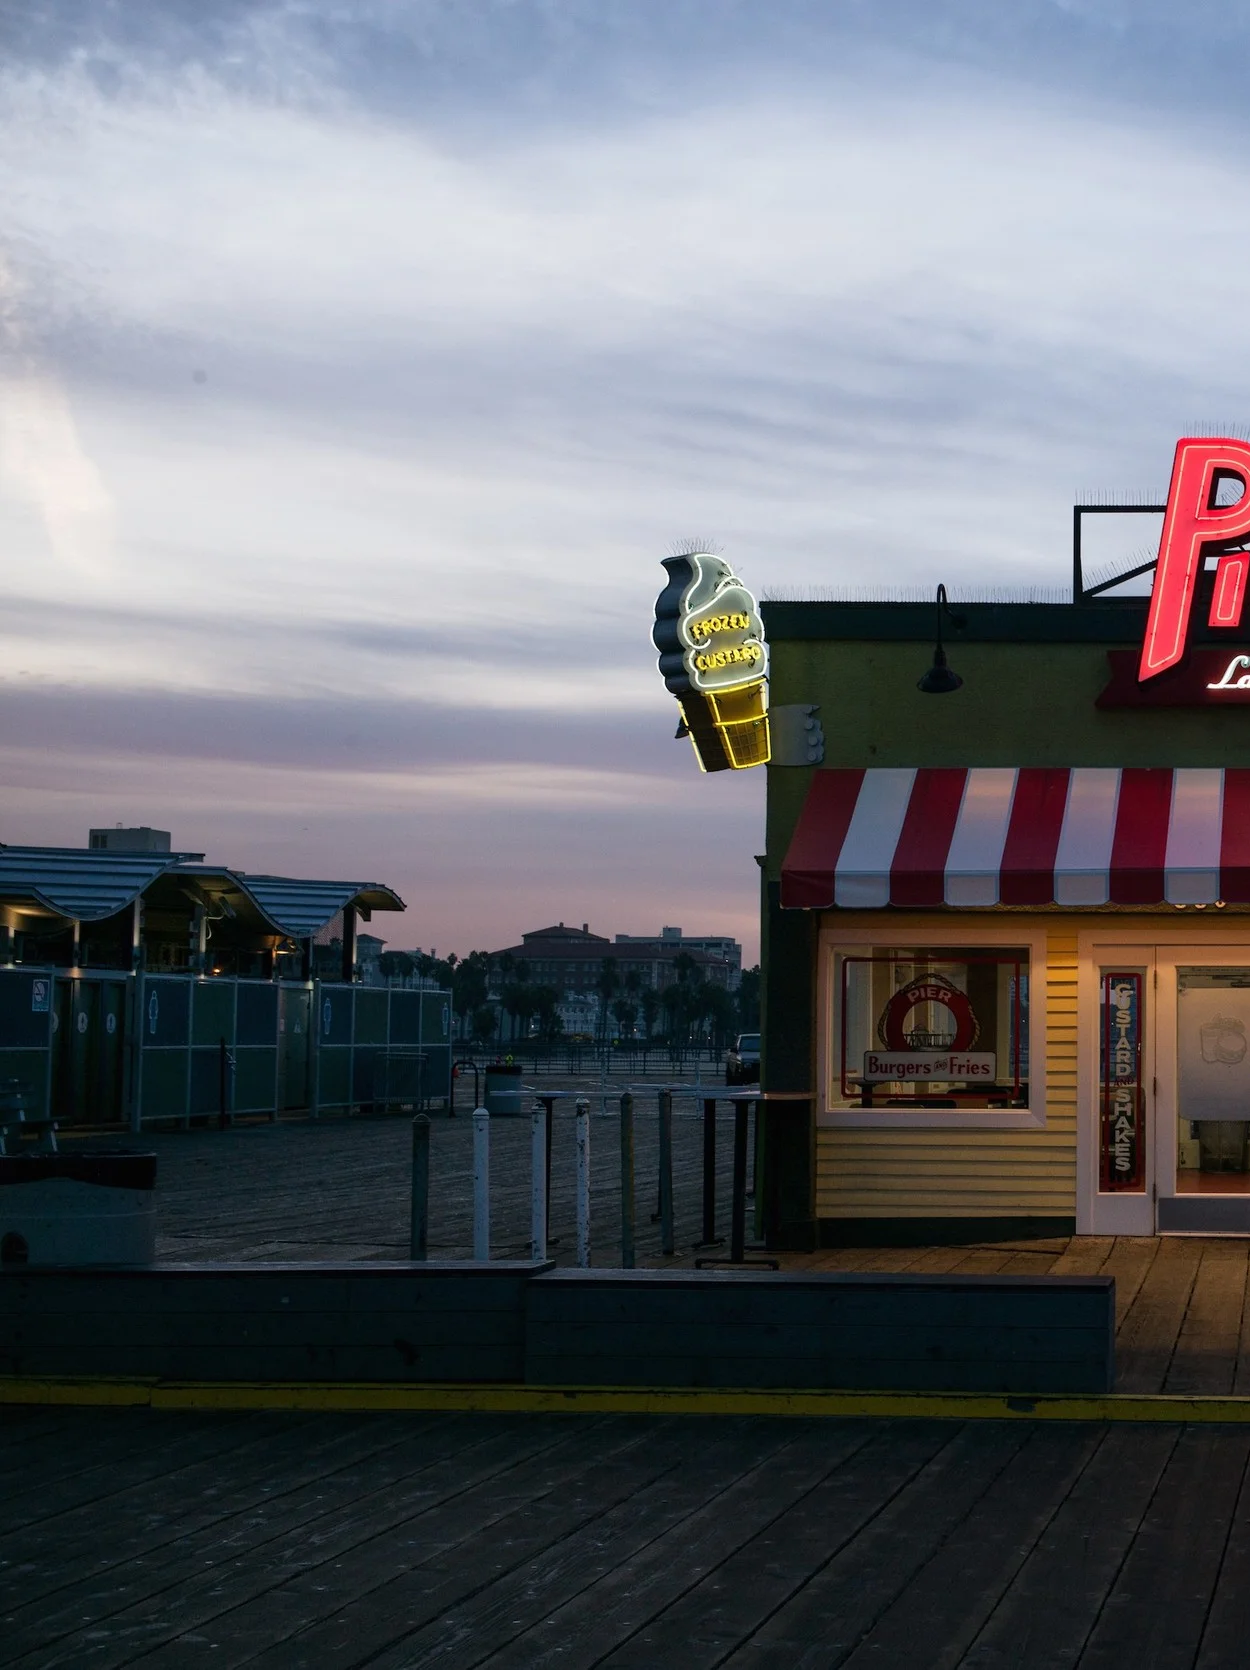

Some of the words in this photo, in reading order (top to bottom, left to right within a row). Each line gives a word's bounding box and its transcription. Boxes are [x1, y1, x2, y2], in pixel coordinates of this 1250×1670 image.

[690, 614, 750, 639] FROZEN
[695, 646, 761, 670] CUSTARD
[906, 986, 953, 1003] PIER
[1115, 983, 1132, 1076] CUSTARD
[868, 1055, 932, 1079] Burgers
[949, 1056, 991, 1075] Fries
[1115, 1089, 1132, 1172] SHAKES
